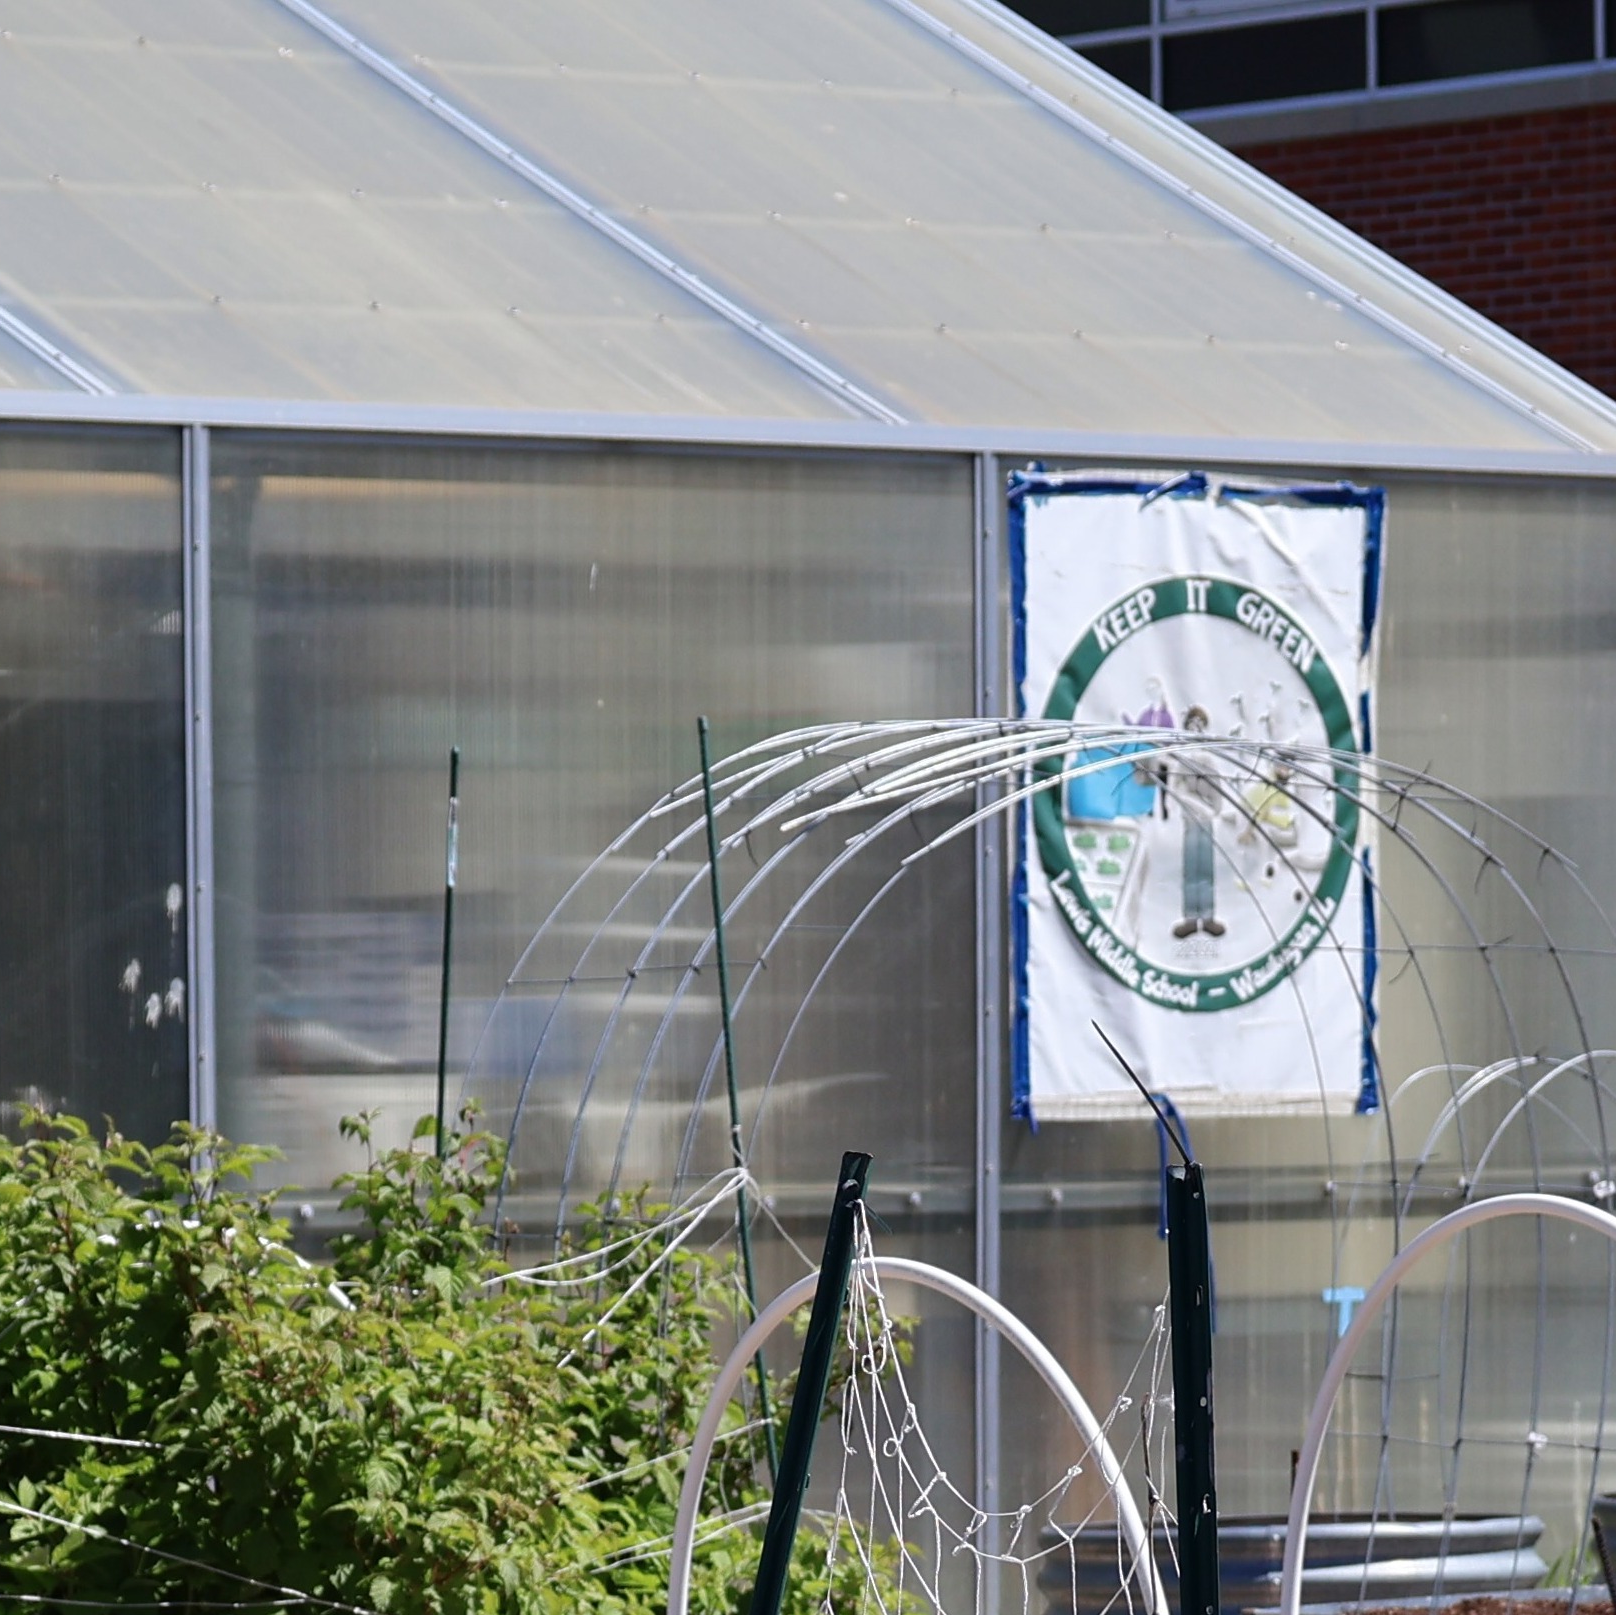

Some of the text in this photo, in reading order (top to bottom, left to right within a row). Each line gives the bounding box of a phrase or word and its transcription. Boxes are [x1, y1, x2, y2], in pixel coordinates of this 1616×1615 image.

[1093, 578, 1317, 674] KEEP IT GREEN
[1086, 924, 1141, 988] Middle
[1141, 970, 1200, 1007] School
